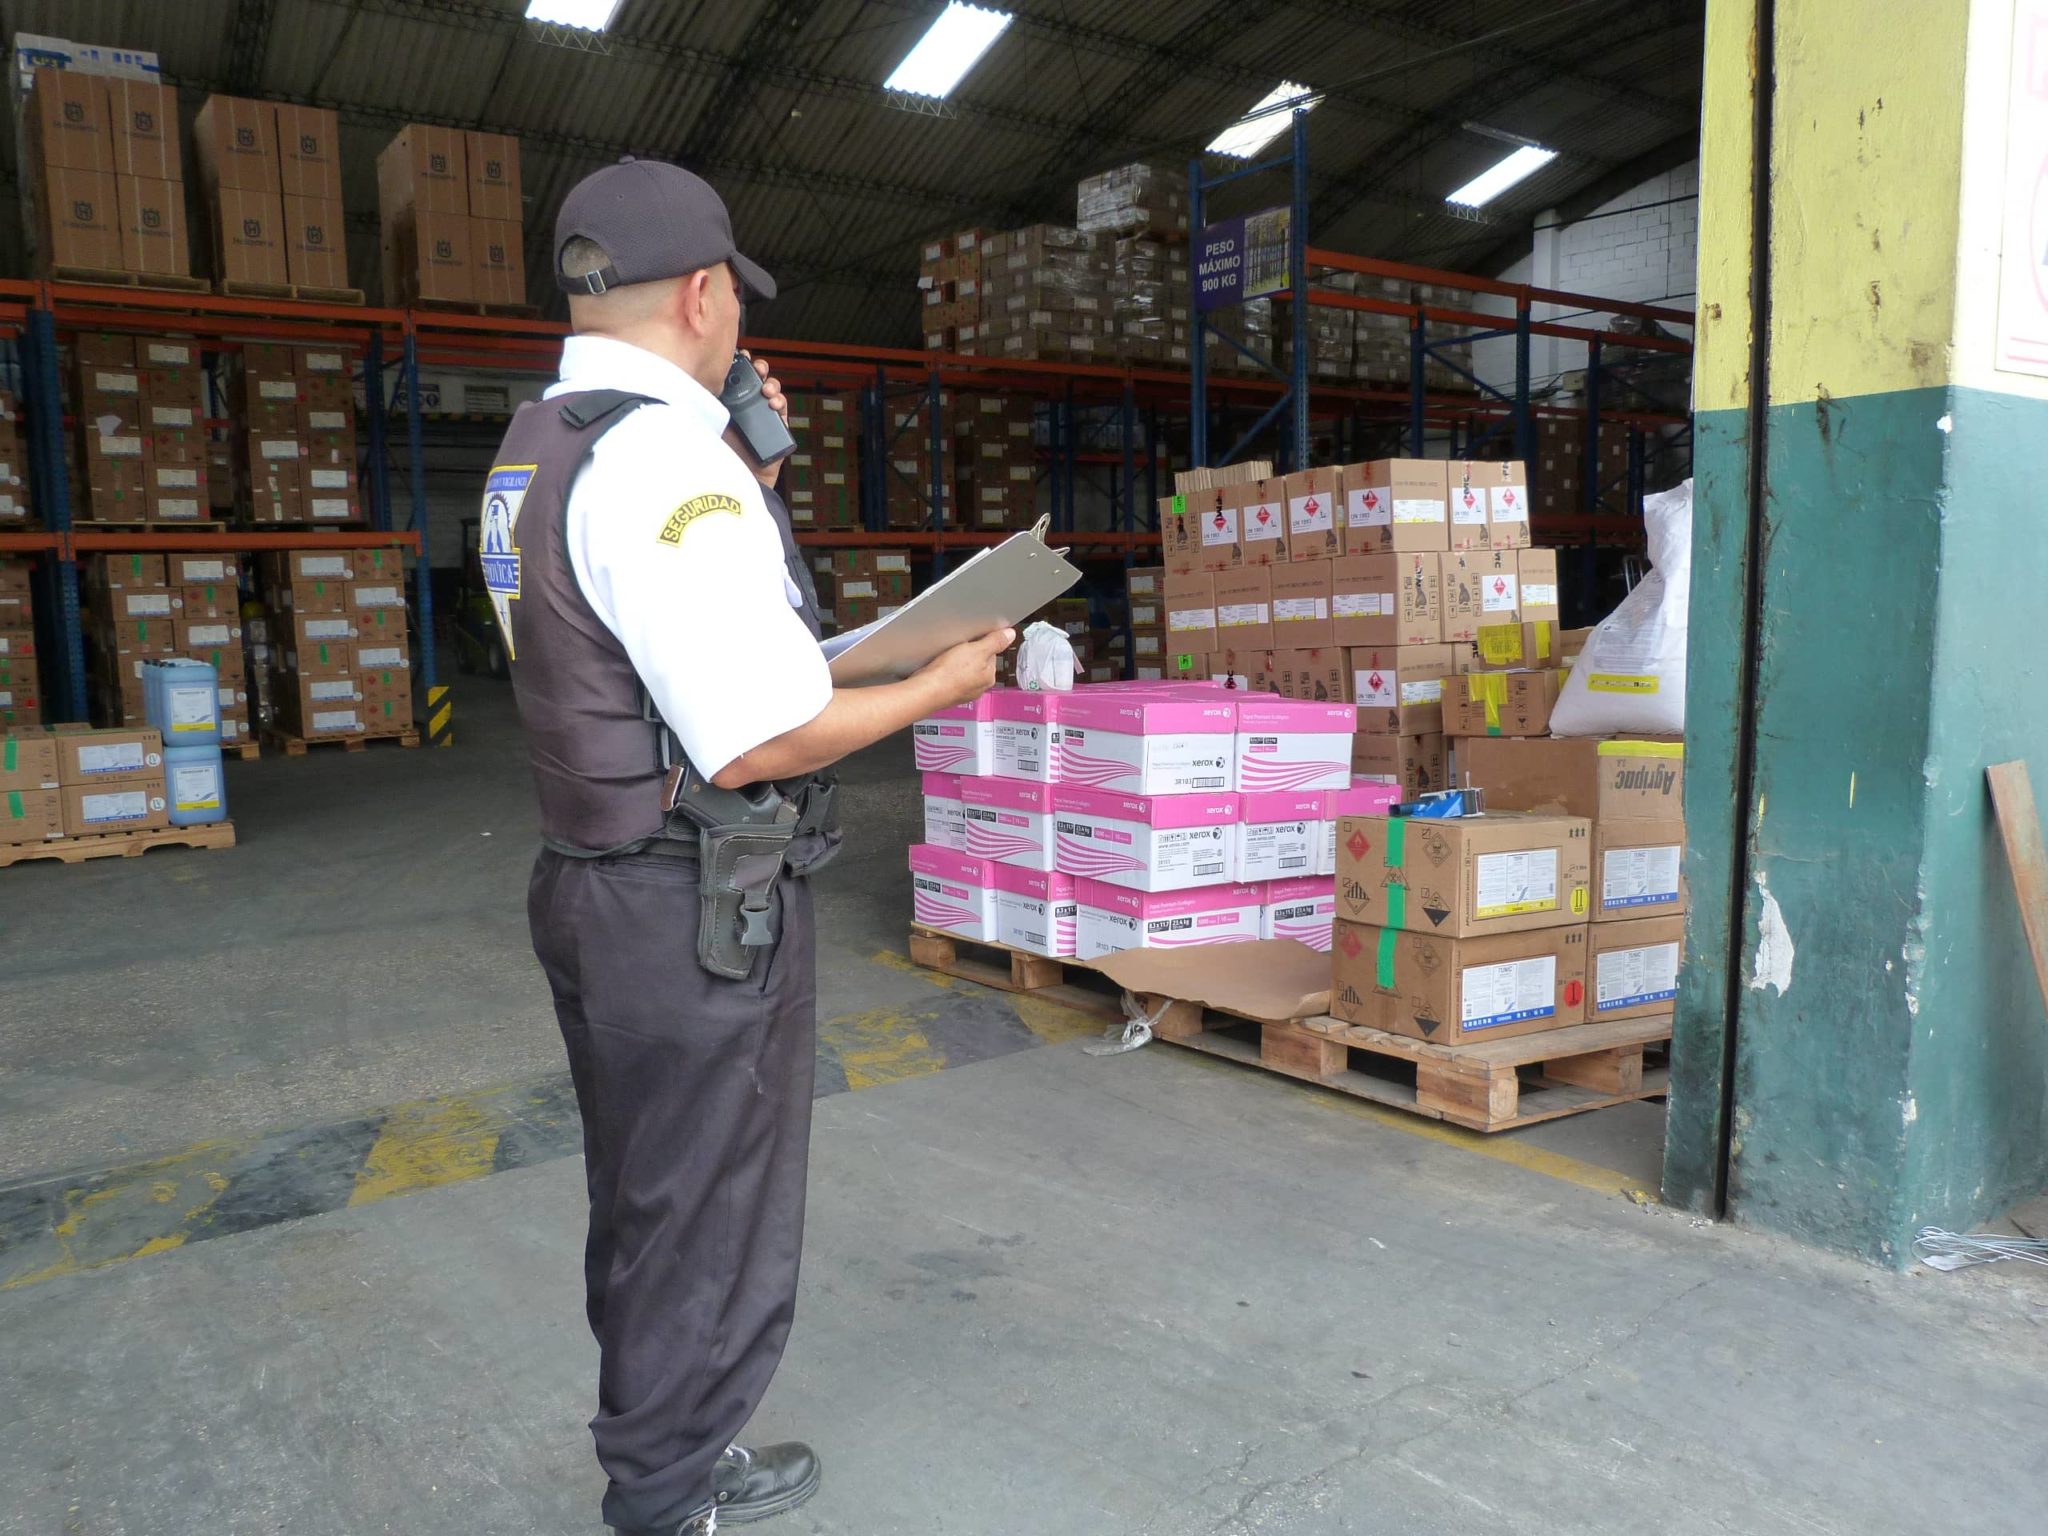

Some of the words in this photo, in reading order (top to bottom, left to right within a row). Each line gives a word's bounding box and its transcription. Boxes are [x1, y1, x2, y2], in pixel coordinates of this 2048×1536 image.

[1206, 240, 1234, 256] PESO
[1198, 256, 1241, 276] MÁXIMO
[1202, 278, 1219, 292] 900
[1222, 273, 1237, 288] KG
[662, 494, 740, 542] SEGURIDAD
[1016, 728, 1030, 736] xerox
[1192, 758, 1214, 768] xerox
[1615, 763, 1676, 796] Agripac
[1123, 802, 1138, 810] xerox
[1276, 824, 1295, 834] xerox
[1189, 831, 1210, 840] xerox
[1232, 887, 1249, 896] xerox
[1117, 895, 1131, 904] xerox
[1022, 902, 1038, 912] xerox
[1109, 915, 1128, 926] xerox
